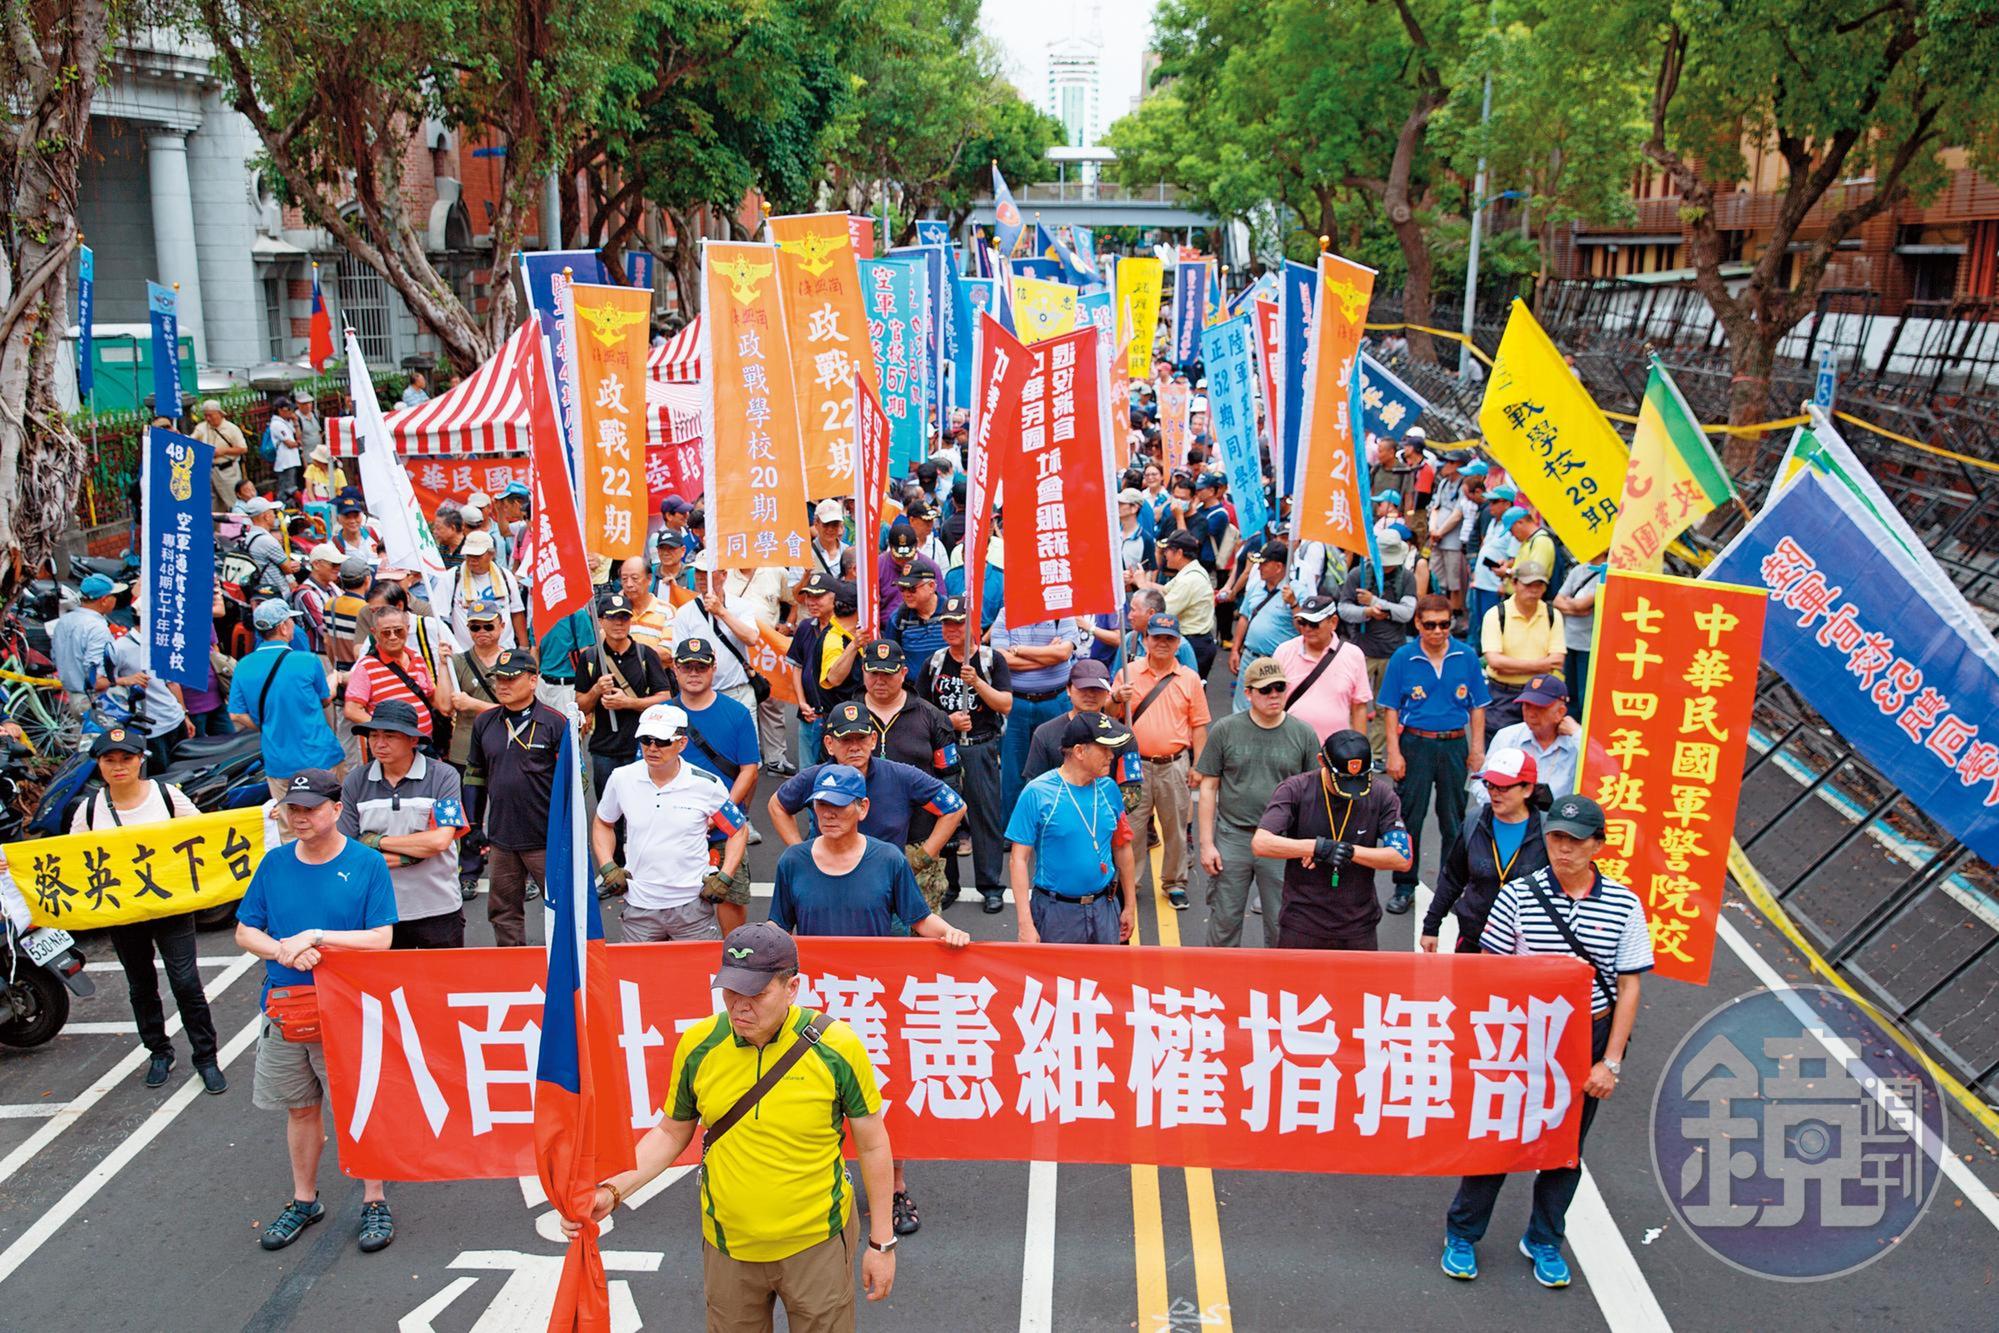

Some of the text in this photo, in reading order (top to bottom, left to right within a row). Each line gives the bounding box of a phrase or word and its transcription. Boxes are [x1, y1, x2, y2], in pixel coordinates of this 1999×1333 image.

[872, 266, 898, 319] 空軍
[165, 442, 184, 461] 48
[595, 373, 632, 546] 政戰22期
[738, 329, 778, 524] 政戰學校20期
[807, 302, 855, 480] 政戰22期
[1210, 338, 1257, 525] 正52期同學會
[1495, 355, 1618, 535] 戰學校29期
[403, 464, 529, 494] 華民國
[726, 530, 806, 560] 同學會
[155, 533, 175, 648] 專科48期七十年班
[1649, 603, 1741, 963] 中華民國軍警院校
[33, 826, 252, 918] 蔡英文下台
